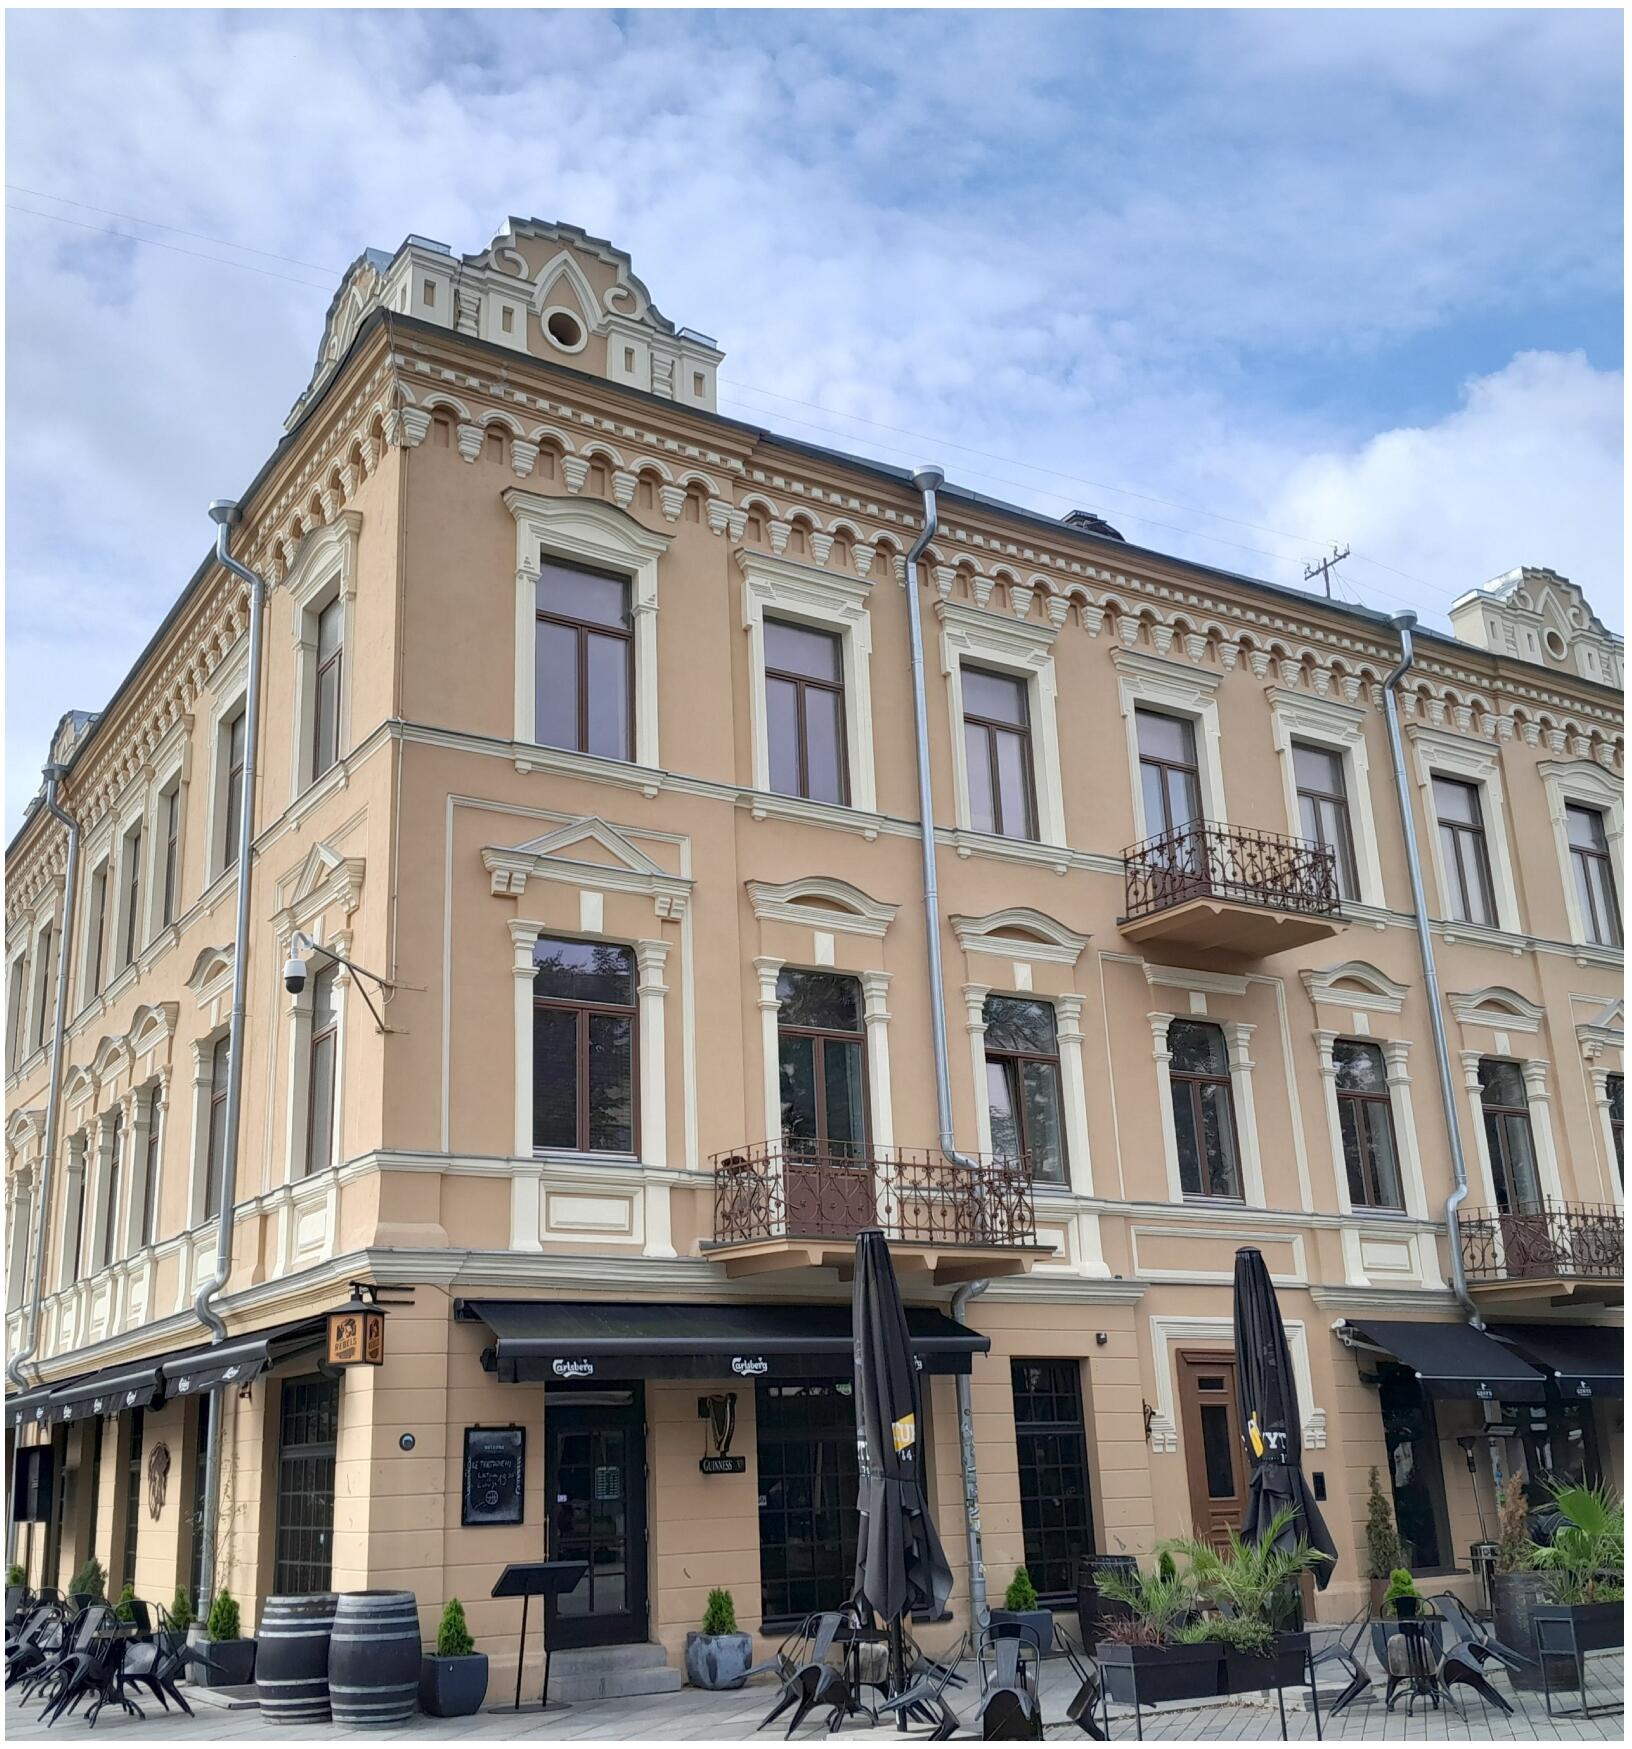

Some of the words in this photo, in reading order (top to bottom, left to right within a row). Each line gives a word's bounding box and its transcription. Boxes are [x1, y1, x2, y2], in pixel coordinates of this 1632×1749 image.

[334, 1336, 358, 1351] REBELS
[552, 1359, 594, 1378] Carlsberg
[732, 1357, 768, 1376] Carlsberg
[703, 1459, 733, 1472] GUINNESS
